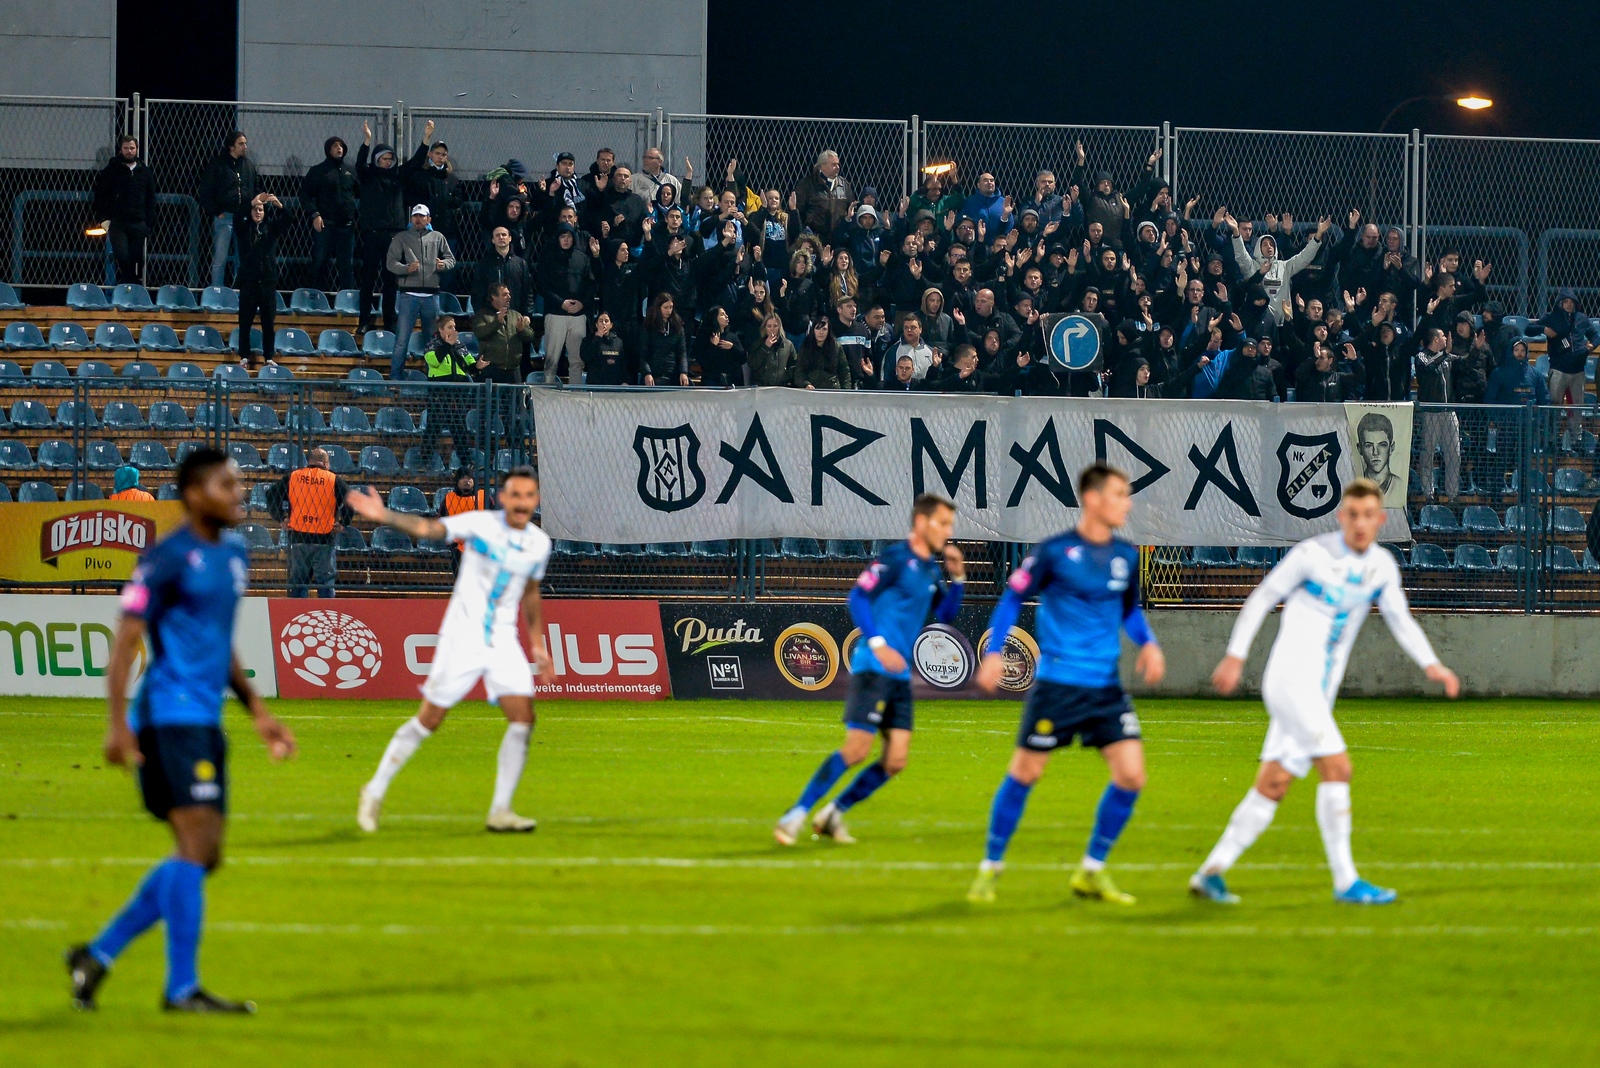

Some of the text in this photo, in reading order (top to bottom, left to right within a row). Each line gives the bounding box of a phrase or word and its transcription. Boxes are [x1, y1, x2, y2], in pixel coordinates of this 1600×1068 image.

[1292, 450, 1305, 462] NK
[714, 411, 1261, 517] ARMADA
[1286, 449, 1332, 499] RIJEKA
[300, 475, 325, 486] REDAR
[51, 511, 147, 552] Ožujsko
[85, 557, 112, 569] Pivo
[0, 620, 116, 677] MED
[784, 652, 826, 661] LIVANJSKI
[565, 683, 662, 695] Industriemontage
